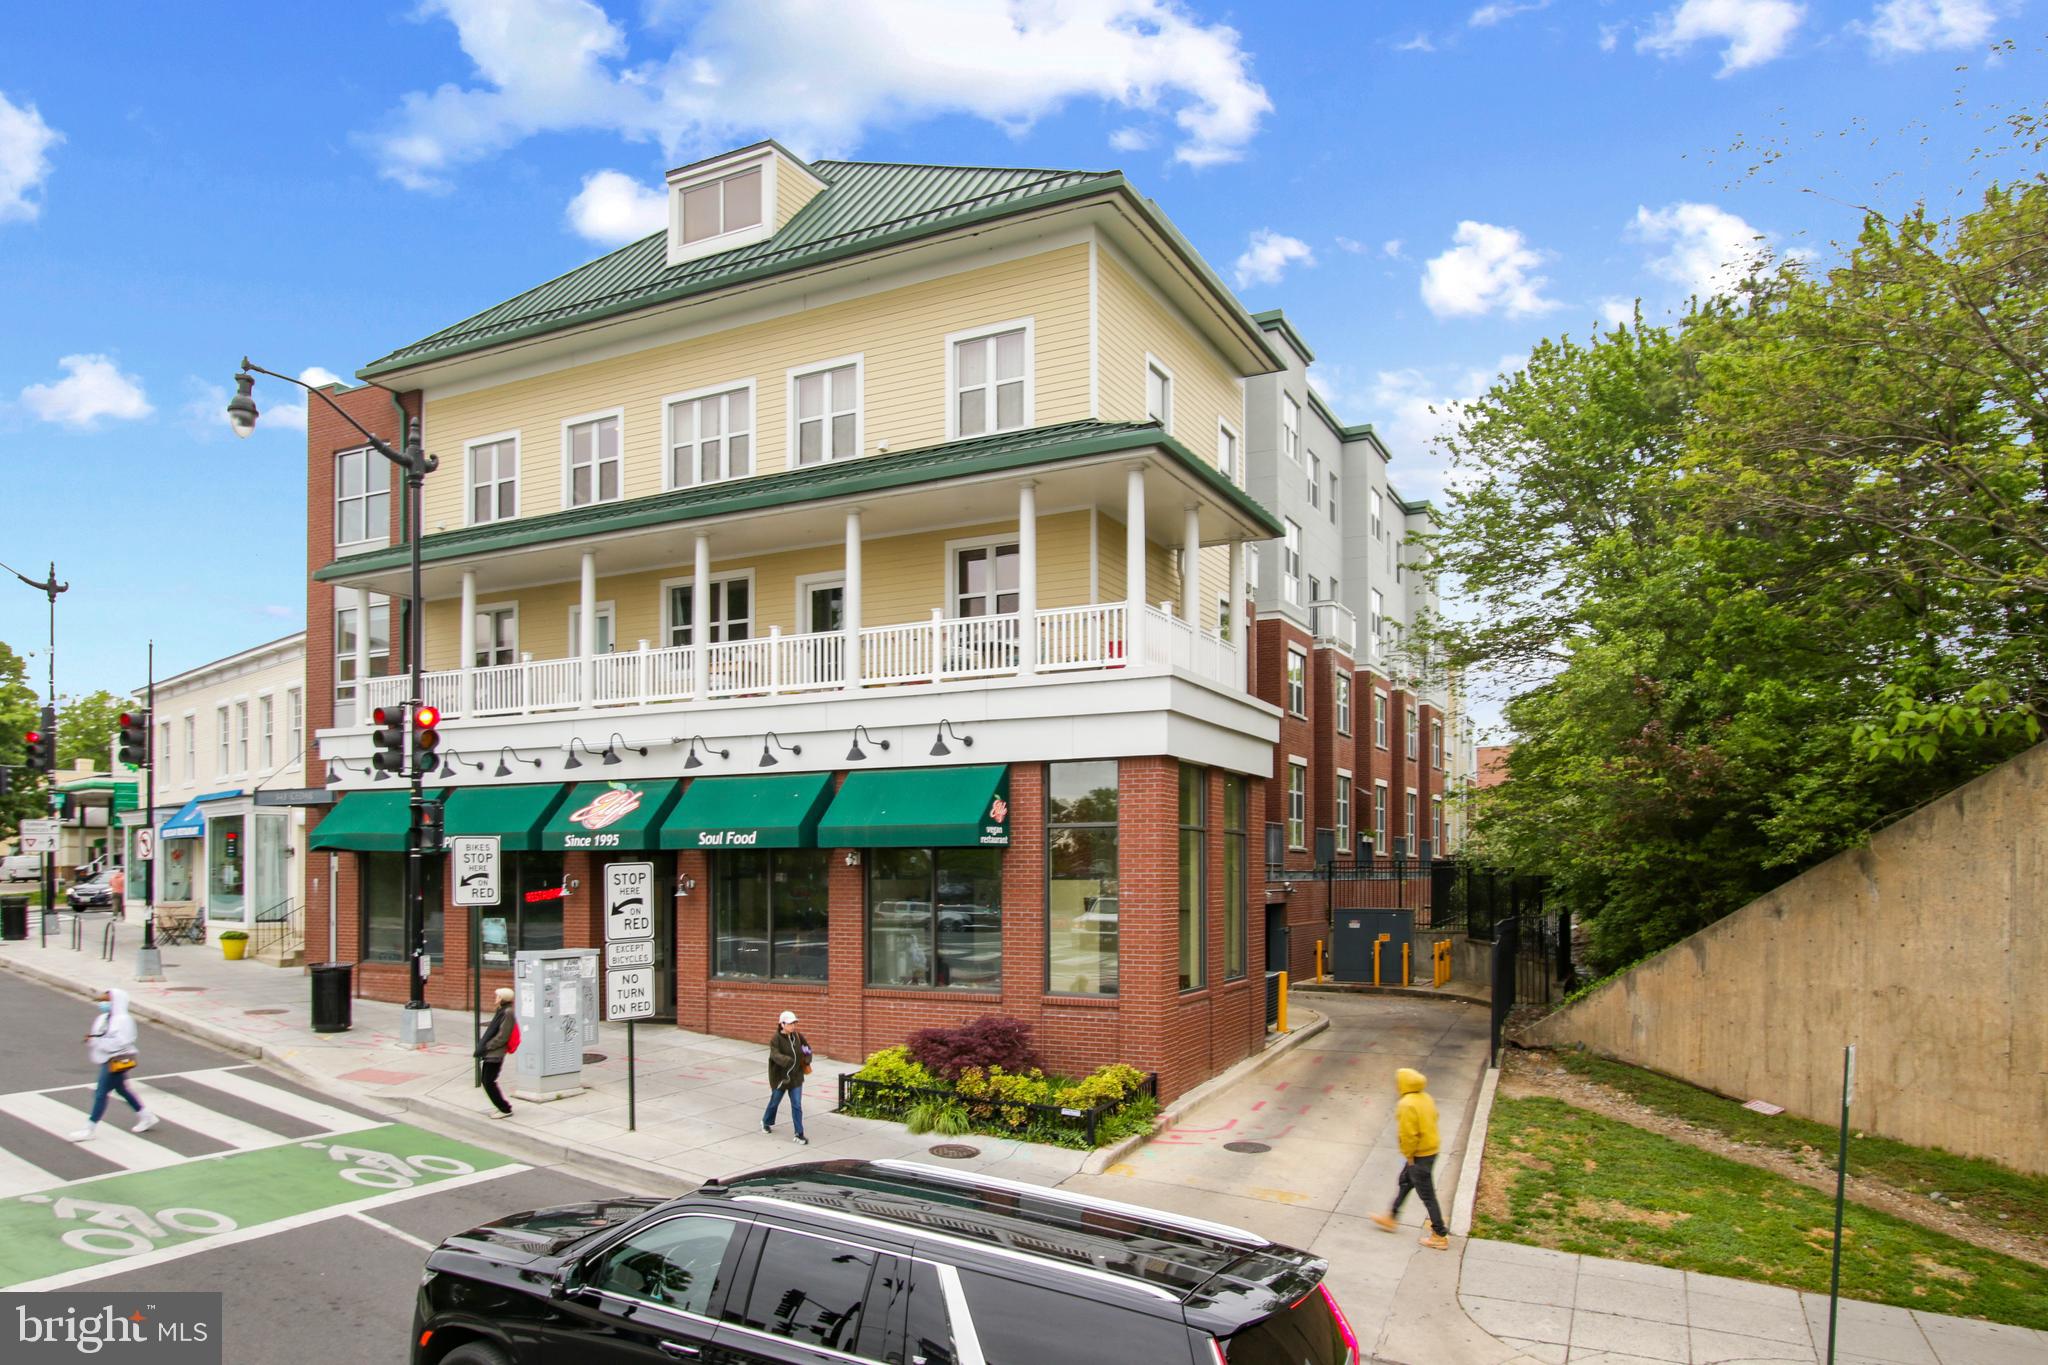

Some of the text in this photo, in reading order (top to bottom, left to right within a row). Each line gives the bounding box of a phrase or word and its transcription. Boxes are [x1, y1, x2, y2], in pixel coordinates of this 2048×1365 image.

[564, 833, 620, 847] Since 1995
[698, 831, 756, 845] Soul Food
[465, 844, 490, 852] BIKES
[463, 853, 493, 864] STOP
[613, 872, 647, 886] STOP
[471, 888, 495, 898] RED
[619, 887, 641, 895] HERE
[630, 907, 641, 916] ON
[624, 917, 649, 930] RED
[615, 944, 644, 954] EXCEPT
[612, 954, 648, 965] BICYCLES
[622, 973, 639, 984] NO
[617, 987, 645, 999] TURN
[611, 1001, 651, 1015] ON RED
